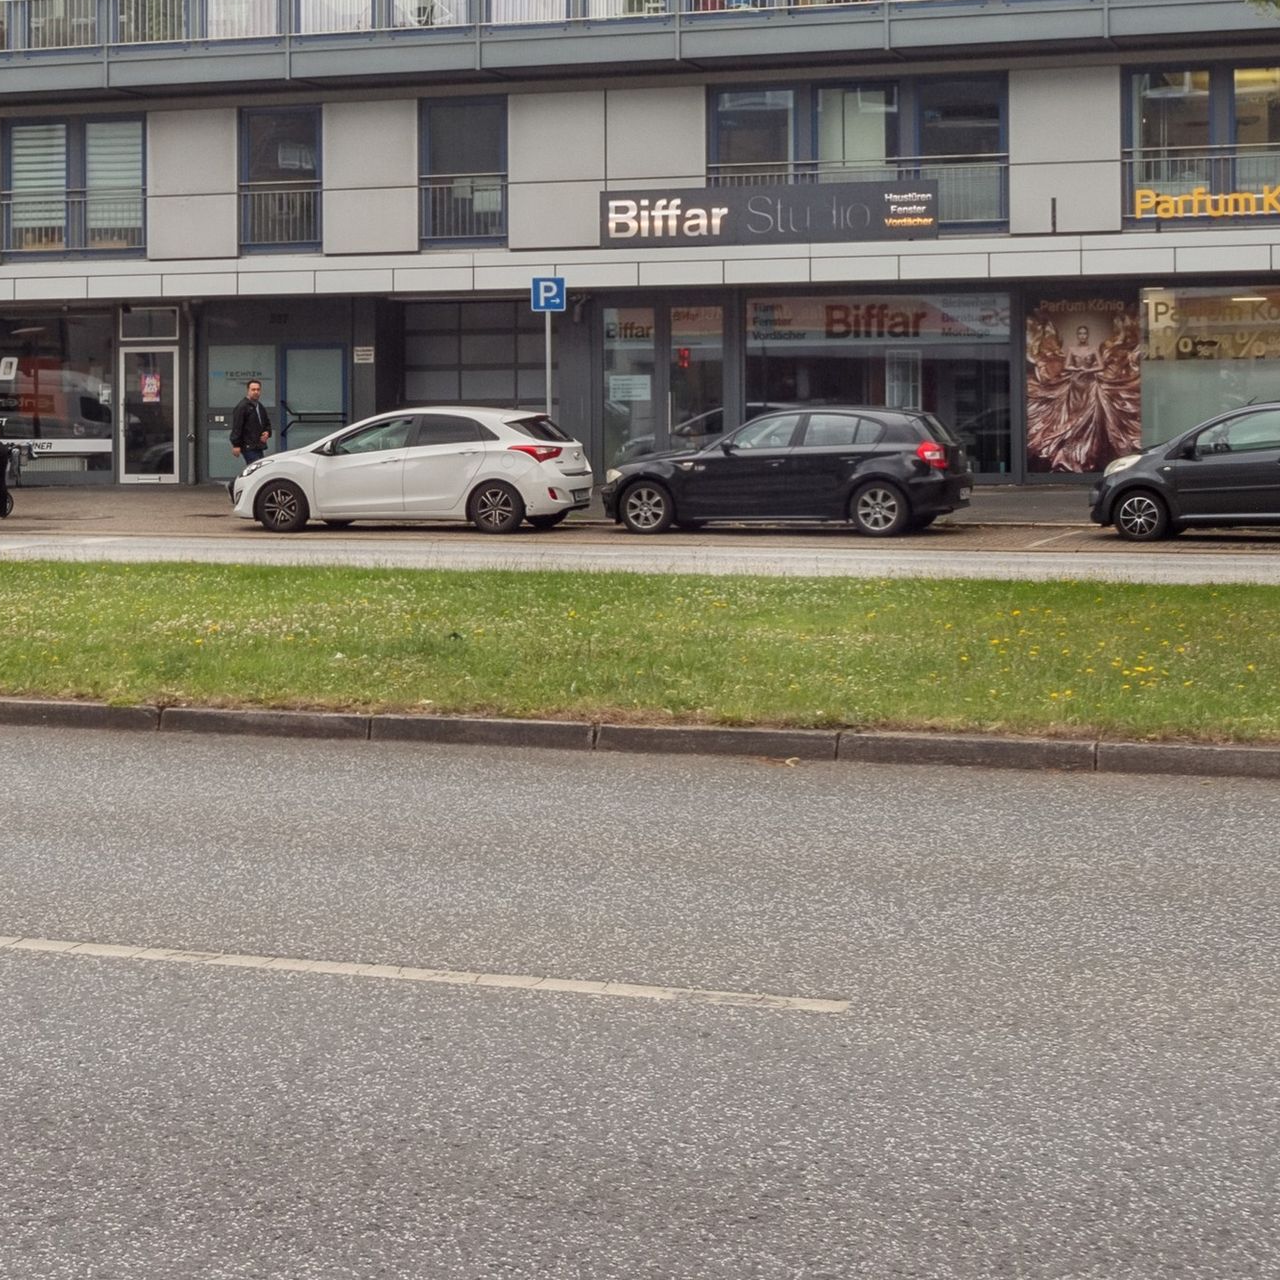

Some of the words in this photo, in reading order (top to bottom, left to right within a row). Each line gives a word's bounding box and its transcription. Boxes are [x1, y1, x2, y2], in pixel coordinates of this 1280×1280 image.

[884, 192, 932, 203] Haustüren
[1136, 187, 1256, 219] Parfum
[890, 204, 927, 215] Fenster
[608, 197, 728, 239] Biffar
[884, 216, 933, 227] Vordächer
[540, 281, 557, 306] P
[1040, 299, 1086, 313] Parfum
[1088, 298, 1124, 312] König
[824, 303, 927, 339] Biffar
[605, 321, 653, 339] Biffar
[752, 329, 807, 340] Vordächer
[941, 327, 991, 339] Montage
